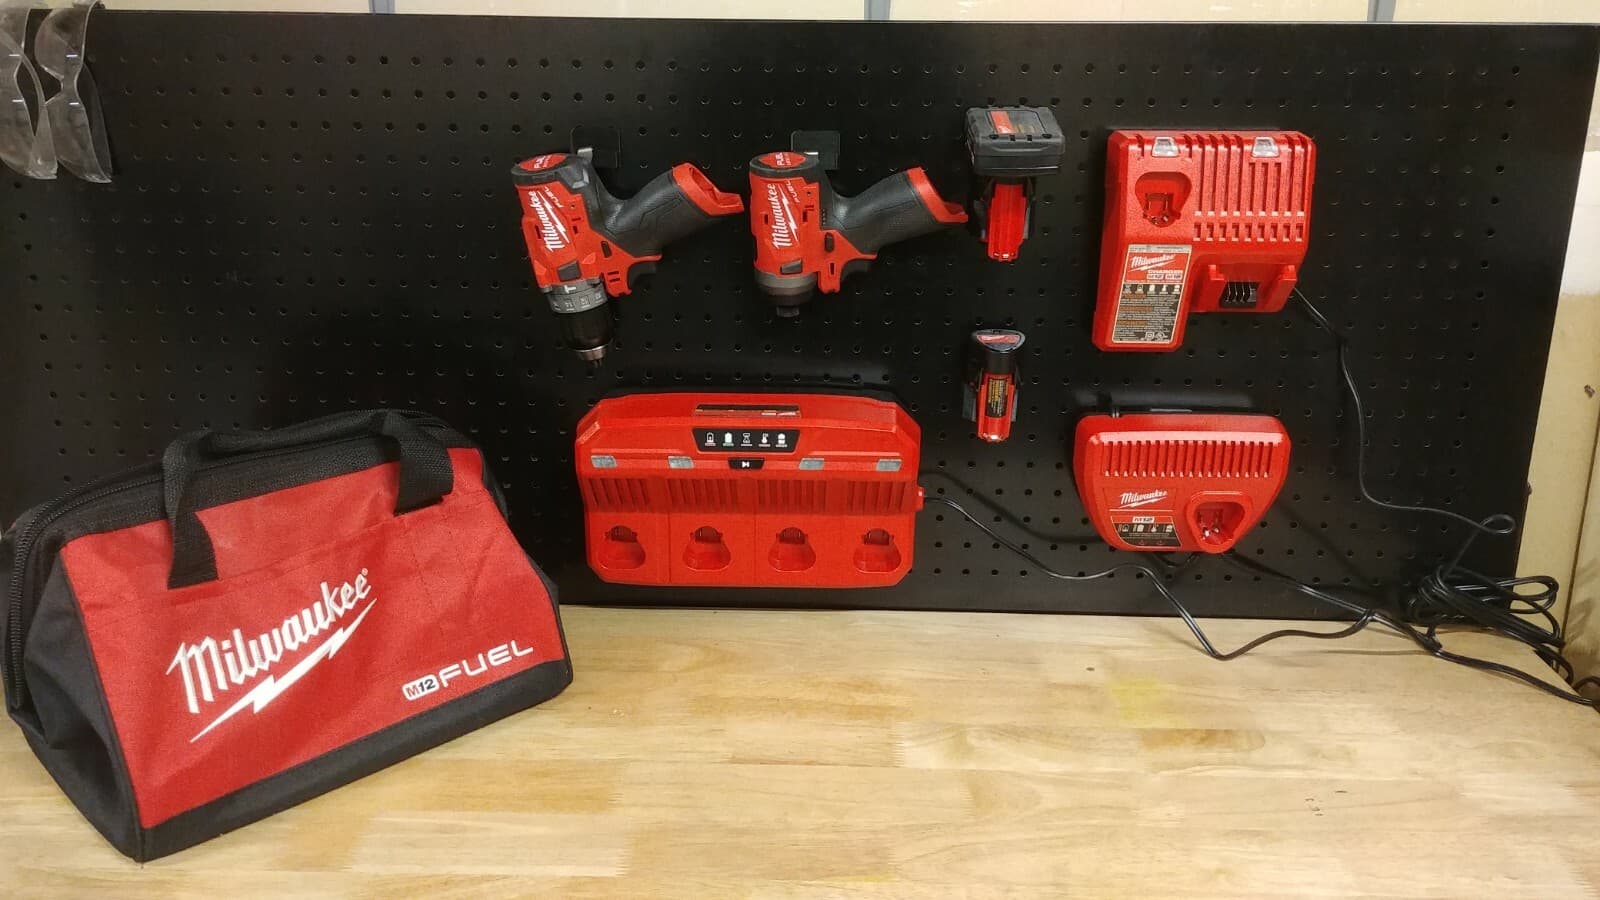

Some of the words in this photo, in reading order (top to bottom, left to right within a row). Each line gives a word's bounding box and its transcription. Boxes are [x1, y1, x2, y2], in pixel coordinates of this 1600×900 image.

[544, 186, 565, 208] FUEL
[786, 179, 801, 203] FUEL
[528, 190, 566, 253] Milwaukee
[767, 184, 793, 249] Milwaukee
[1129, 253, 1177, 269] Milwaukee
[1119, 489, 1168, 504] Milwaukee
[165, 573, 371, 714] Milwaukee
[406, 678, 436, 698] M12
[438, 640, 534, 688] FUEL
